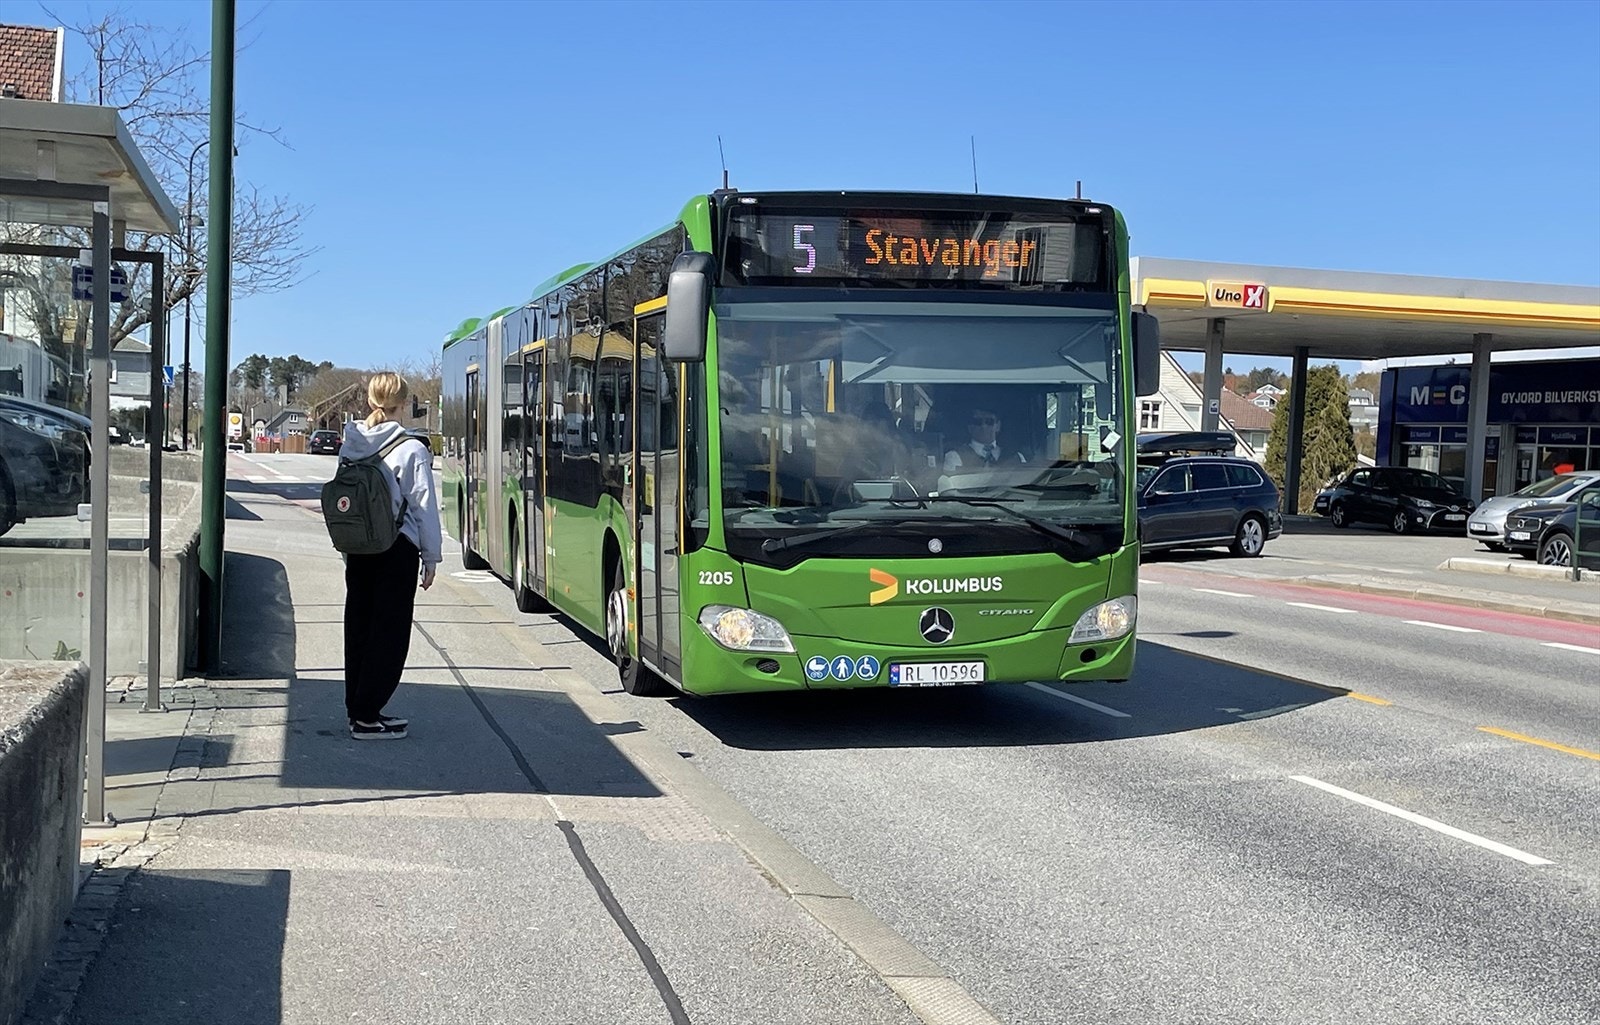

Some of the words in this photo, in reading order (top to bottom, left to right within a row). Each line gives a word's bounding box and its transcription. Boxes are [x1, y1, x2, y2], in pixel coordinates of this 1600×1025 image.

[793, 224, 816, 274] 5
[865, 229, 1036, 277] Stavanger
[1215, 288, 1242, 302] Uno
[1245, 286, 1265, 307] X
[1501, 392, 1542, 404] ØYJORD
[698, 570, 734, 586] 2205
[906, 576, 1003, 595] KOLUMBUS
[905, 666, 923, 681] RL
[931, 664, 978, 681] 10596
